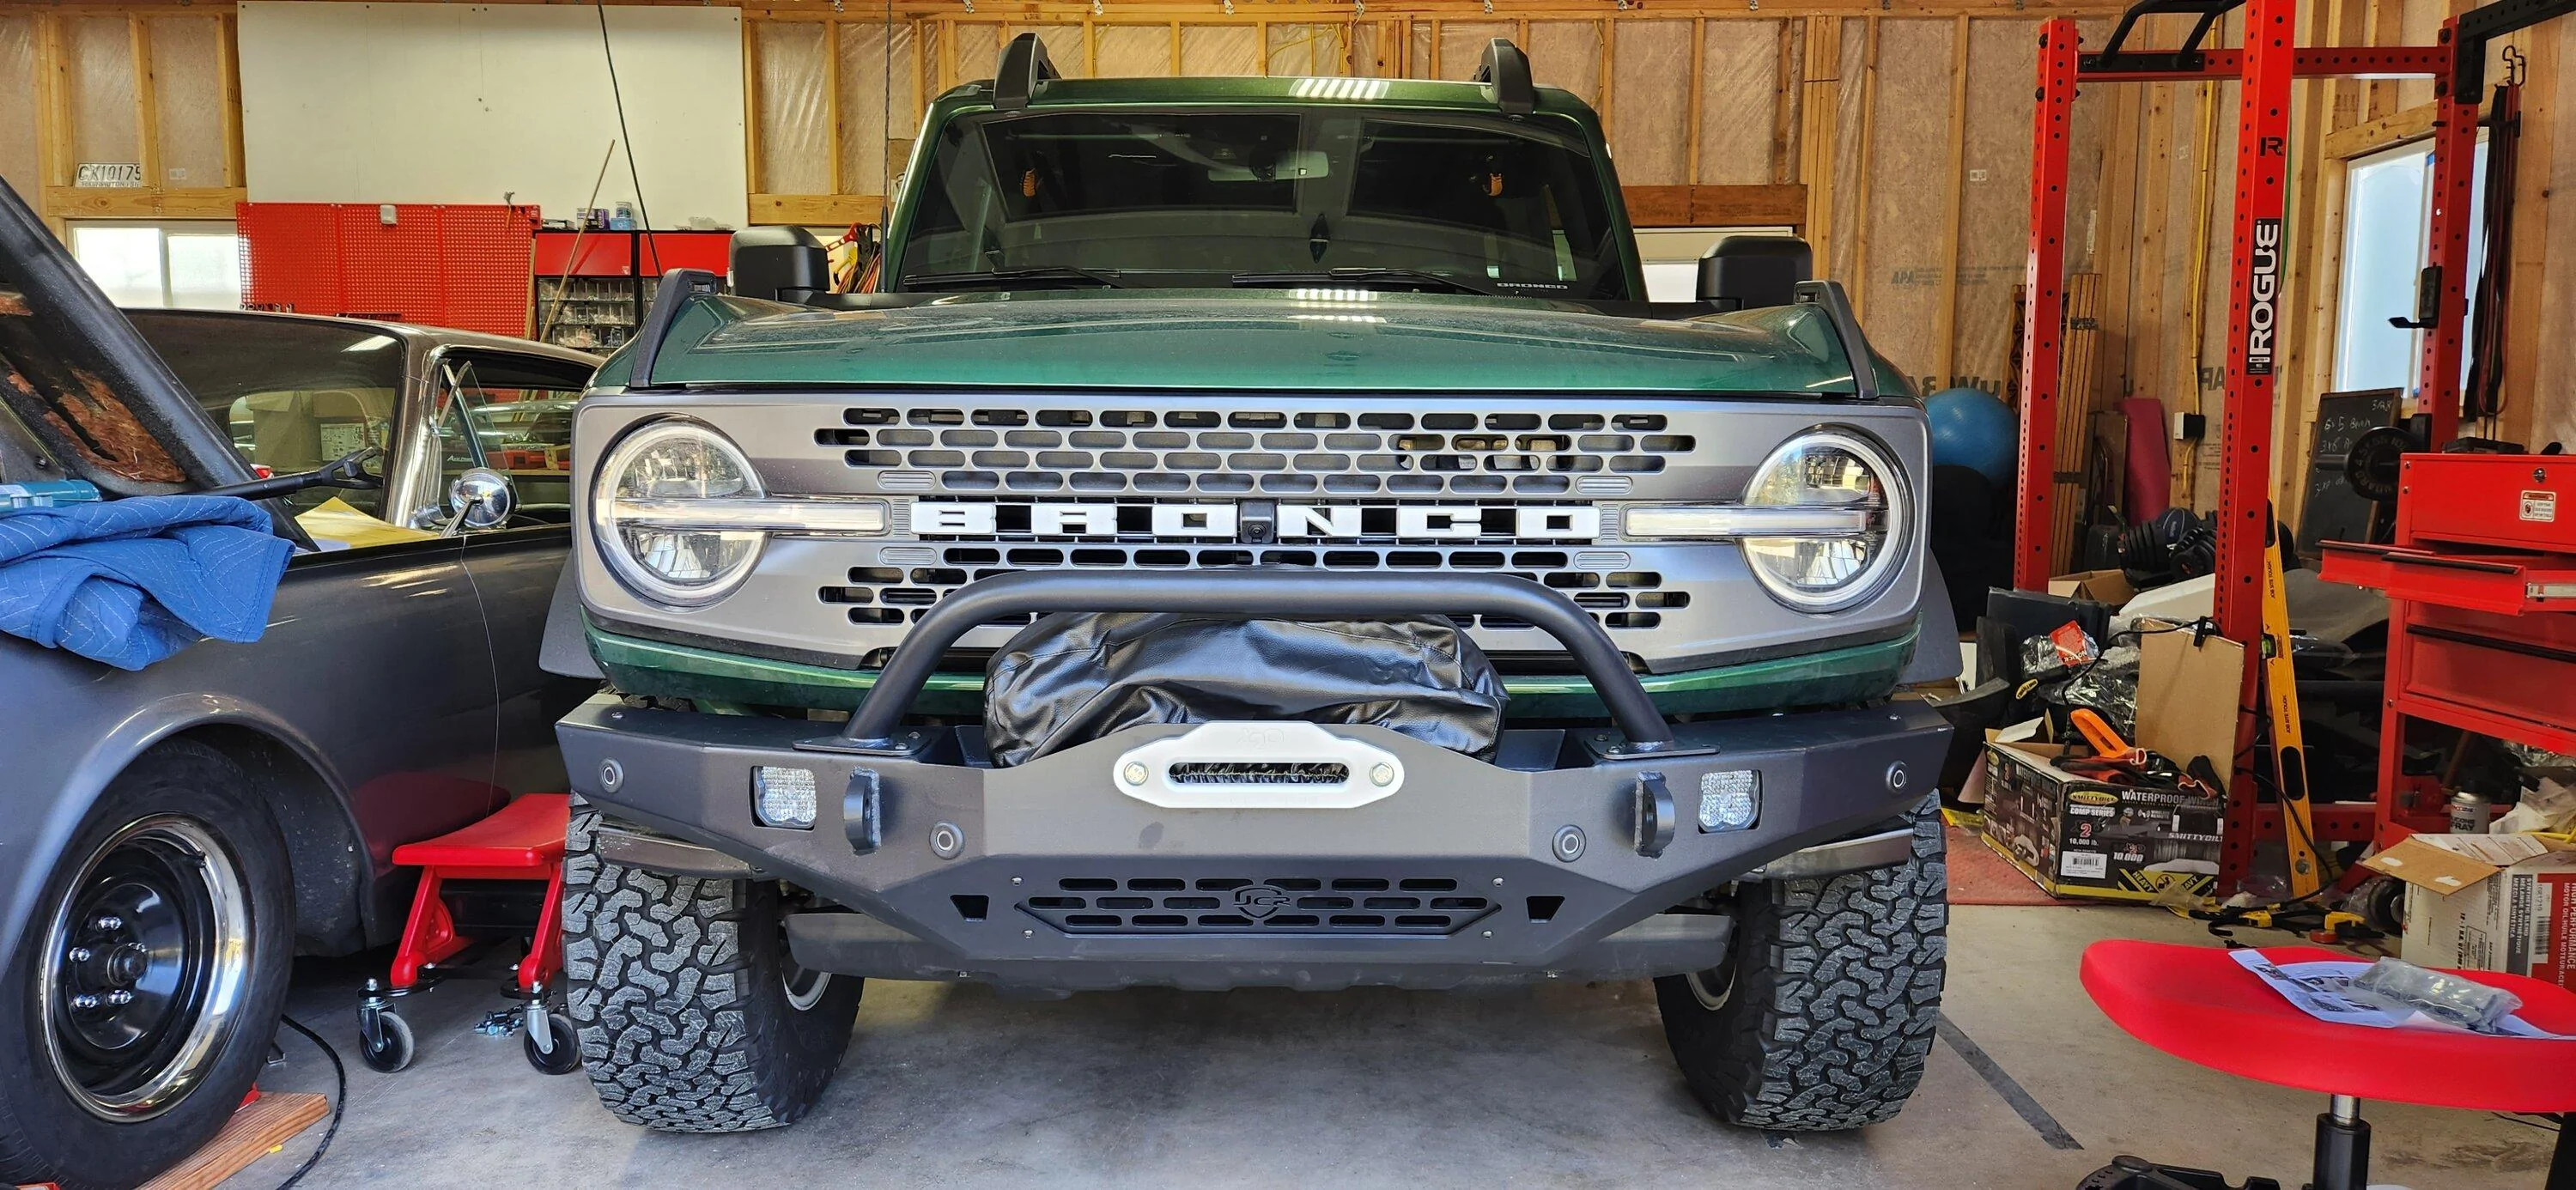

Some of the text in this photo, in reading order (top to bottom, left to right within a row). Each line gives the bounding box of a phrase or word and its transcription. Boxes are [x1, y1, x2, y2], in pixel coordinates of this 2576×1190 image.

[2250, 223, 2278, 355] ROGUE
[910, 501, 1601, 539] BRONCO
[2121, 789, 2185, 804] WATERPROOF
[2091, 808, 2114, 817] SERIES
[2069, 837, 2090, 846] 10,000
[2567, 907, 2576, 969] PERFORMANCE
